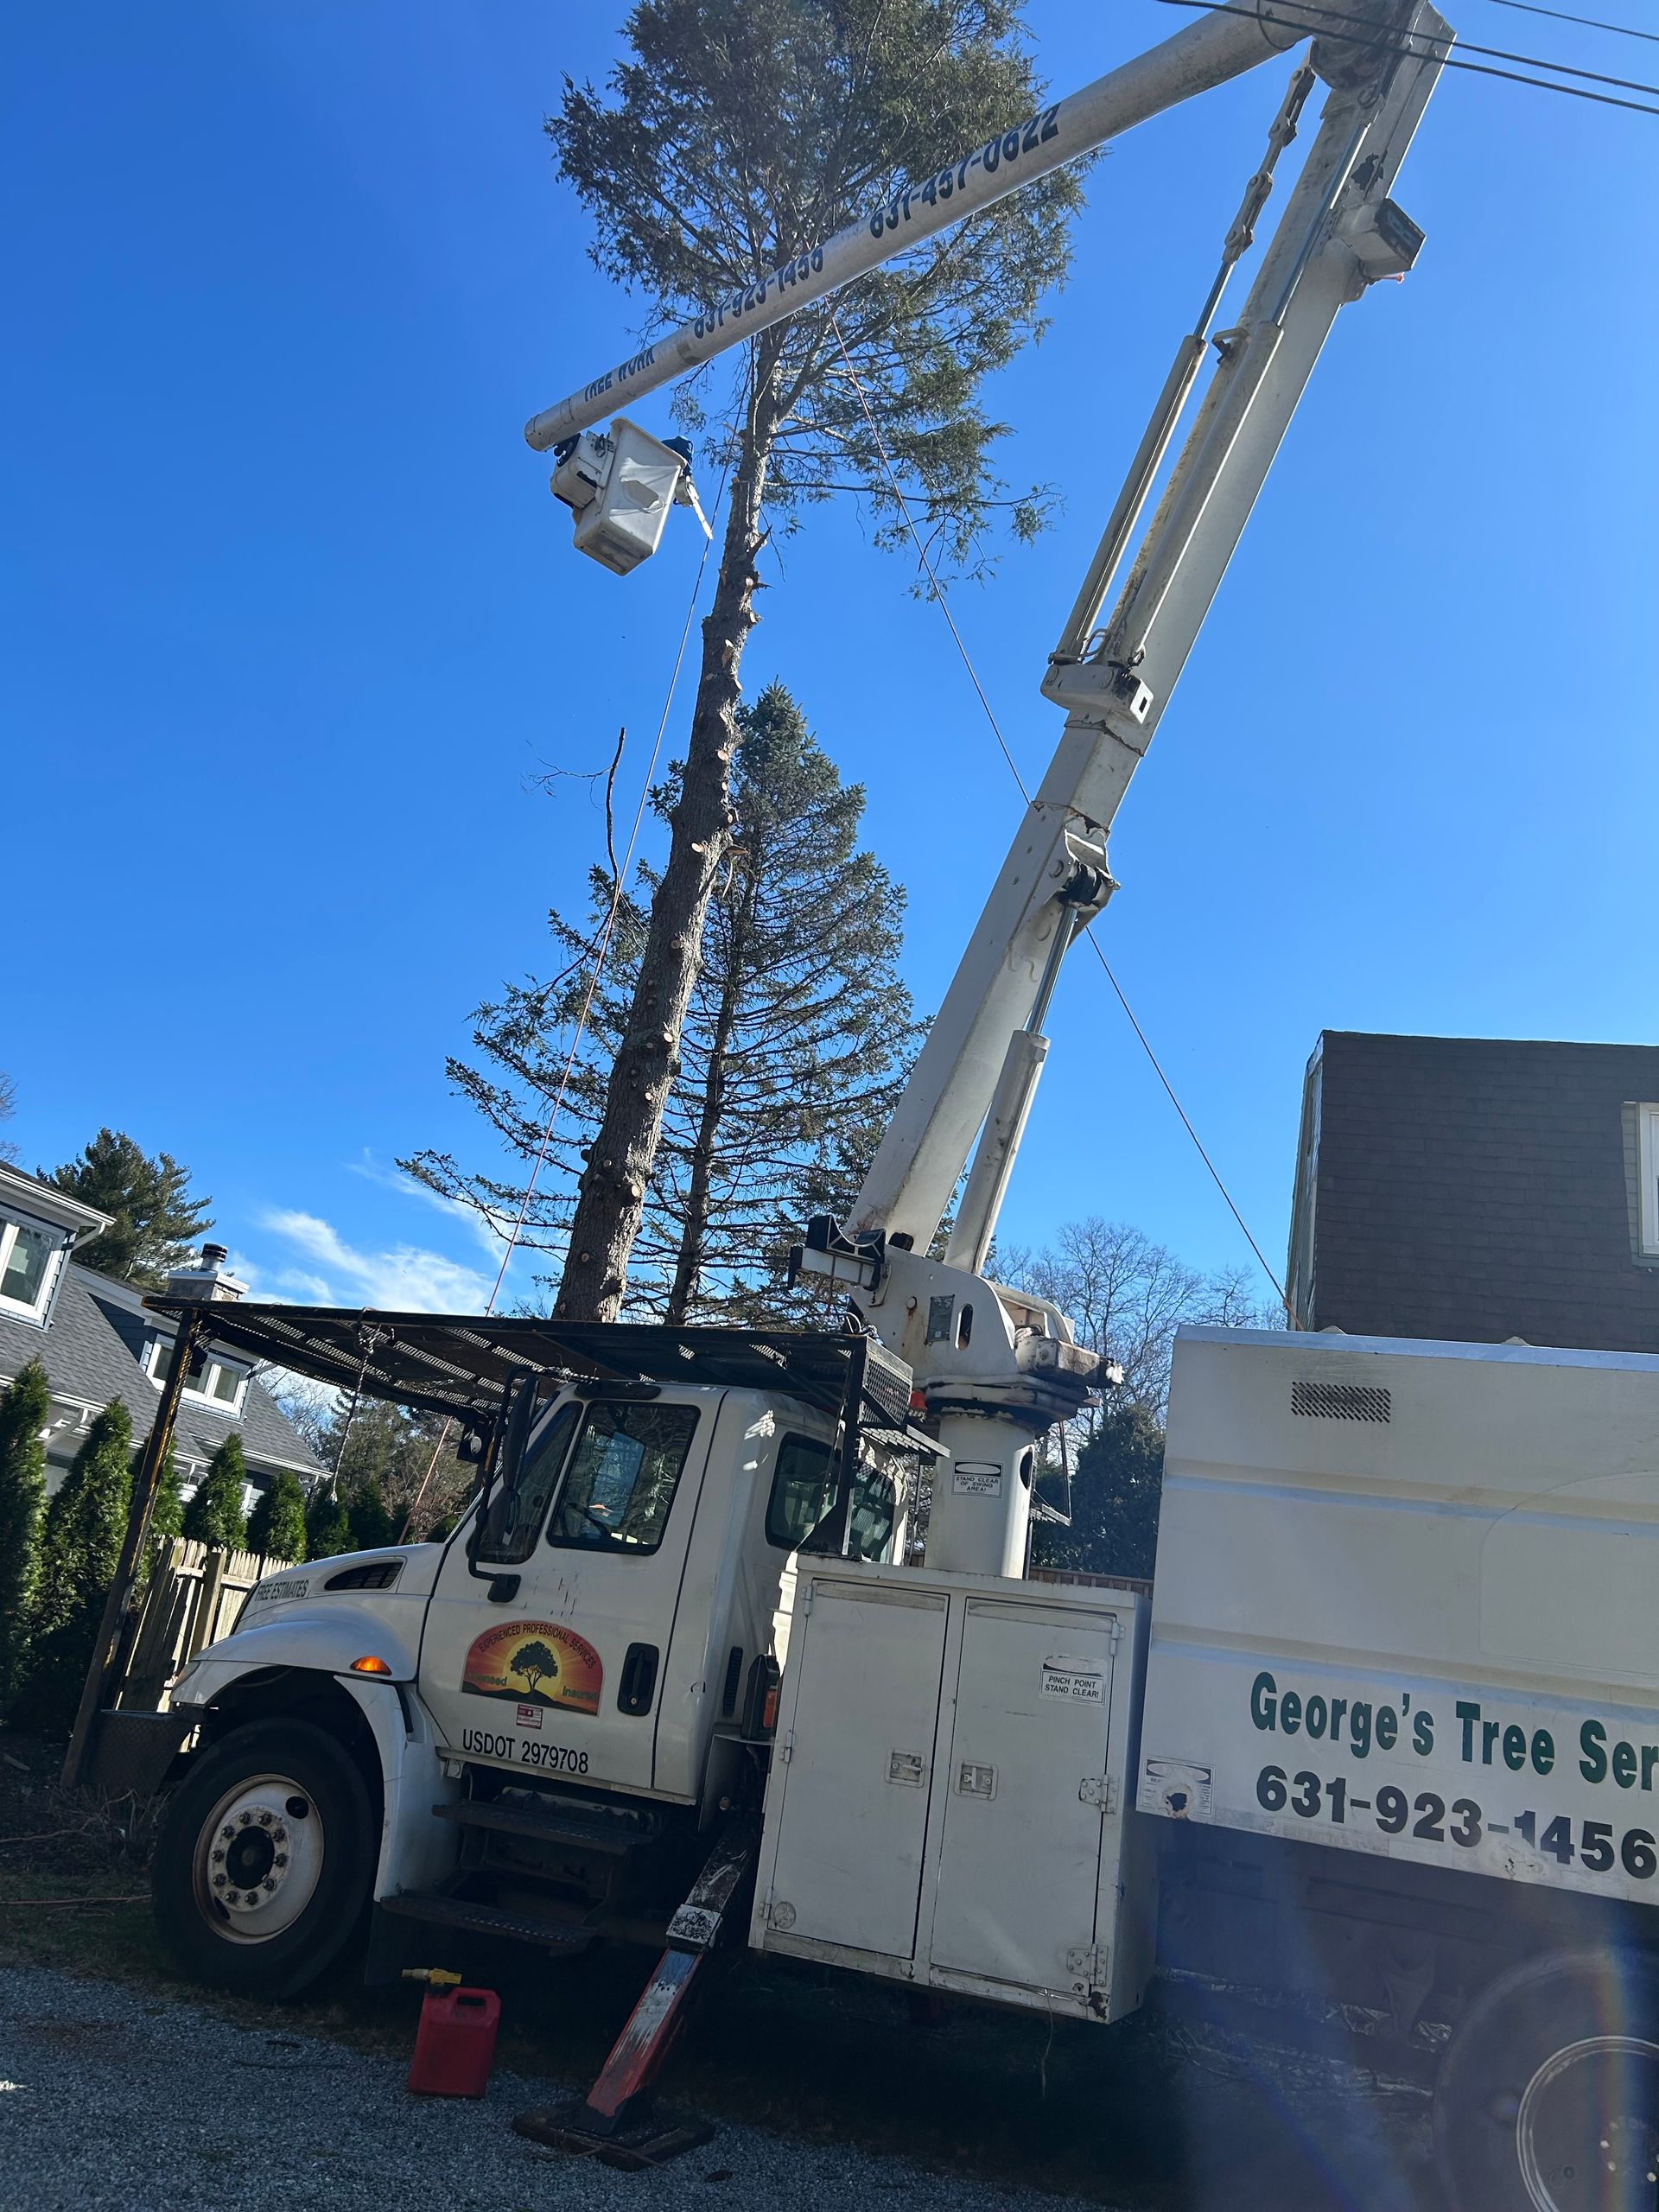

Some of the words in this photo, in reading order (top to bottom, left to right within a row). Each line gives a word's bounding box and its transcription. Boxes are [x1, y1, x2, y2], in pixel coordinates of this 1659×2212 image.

[255, 1582, 273, 1601] FREE
[270, 1579, 309, 1599] ESTIMATES
[478, 1624, 521, 1652] EXPERIENCED
[523, 1623, 569, 1643] PROFESSIONAL
[569, 1637, 597, 1669] SERVICES
[1045, 1684, 1069, 1694] STAND
[1072, 1688, 1099, 1698] CLEAR!
[1048, 1675, 1071, 1685] PINCH
[1074, 1679, 1096, 1689] POINT
[1250, 1671, 1434, 1758] George's
[1455, 1700, 1555, 1776] Tree
[462, 1728, 516, 1759] USDOT
[521, 1740, 589, 1775] 2979708
[1255, 1764, 1657, 1880] 631-923-1456
